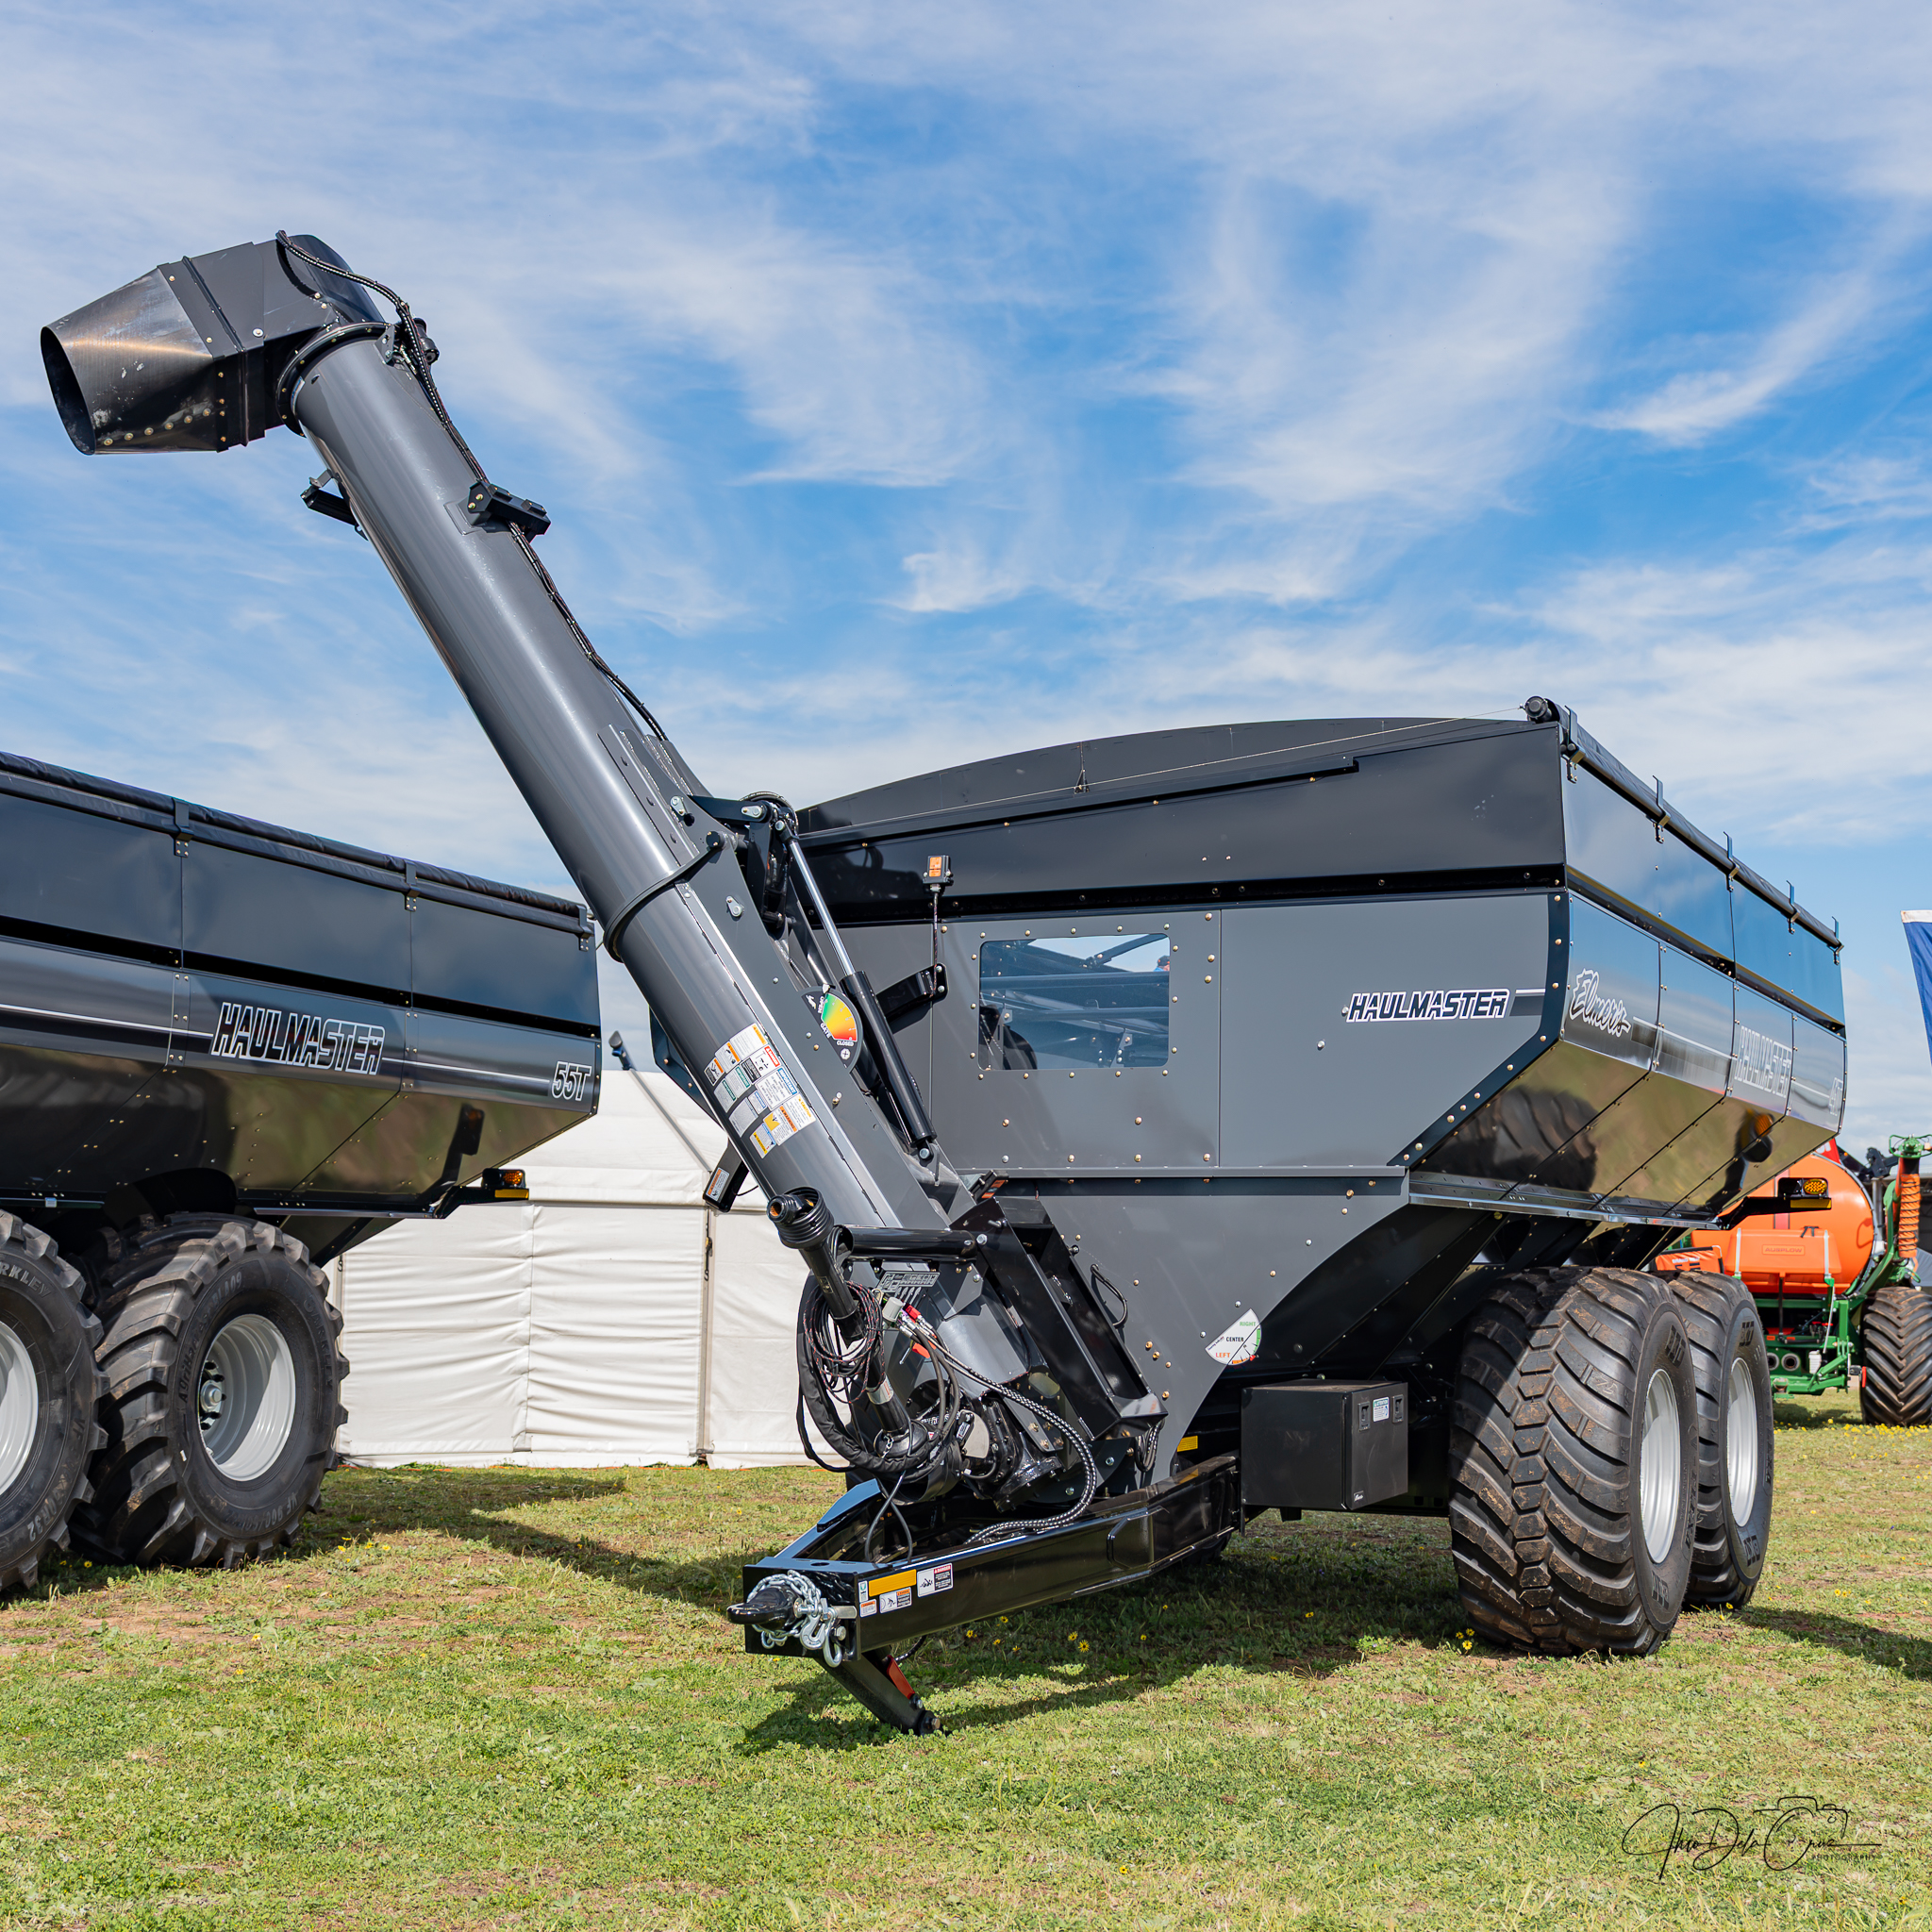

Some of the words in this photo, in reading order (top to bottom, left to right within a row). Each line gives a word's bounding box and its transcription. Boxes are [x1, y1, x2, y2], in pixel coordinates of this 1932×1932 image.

[1346, 989, 1509, 1023] HAULMASTER
[210, 1001, 386, 1075] HAULMASTER
[820, 1023, 832, 1039] GATE
[551, 1061, 591, 1101] 55T
[1734, 1025, 1792, 1099] HAULMASTER
